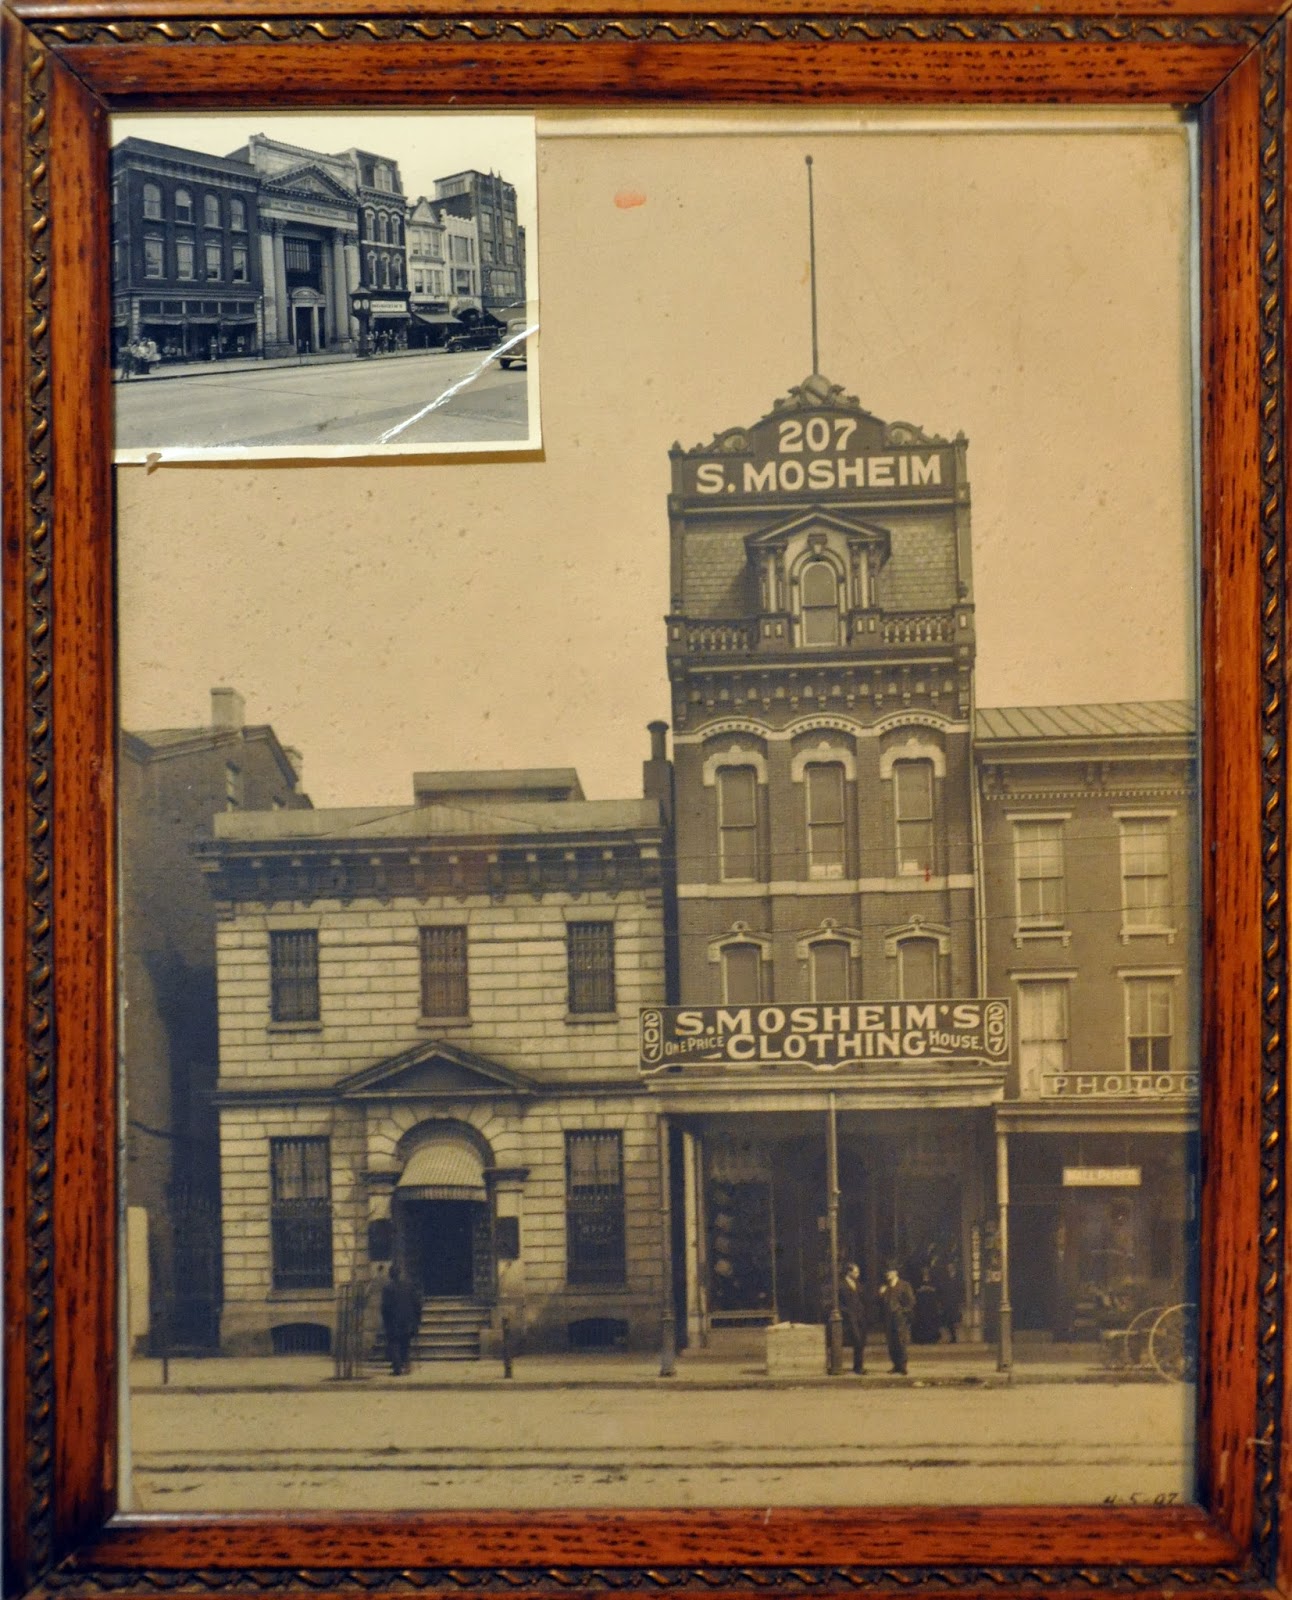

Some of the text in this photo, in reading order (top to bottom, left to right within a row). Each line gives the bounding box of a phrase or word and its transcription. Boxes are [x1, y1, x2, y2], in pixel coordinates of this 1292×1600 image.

[778, 417, 857, 453] 207
[643, 1012, 660, 1058] 207
[726, 1031, 927, 1060] CLOTHING
[988, 1006, 1004, 1051] 207
